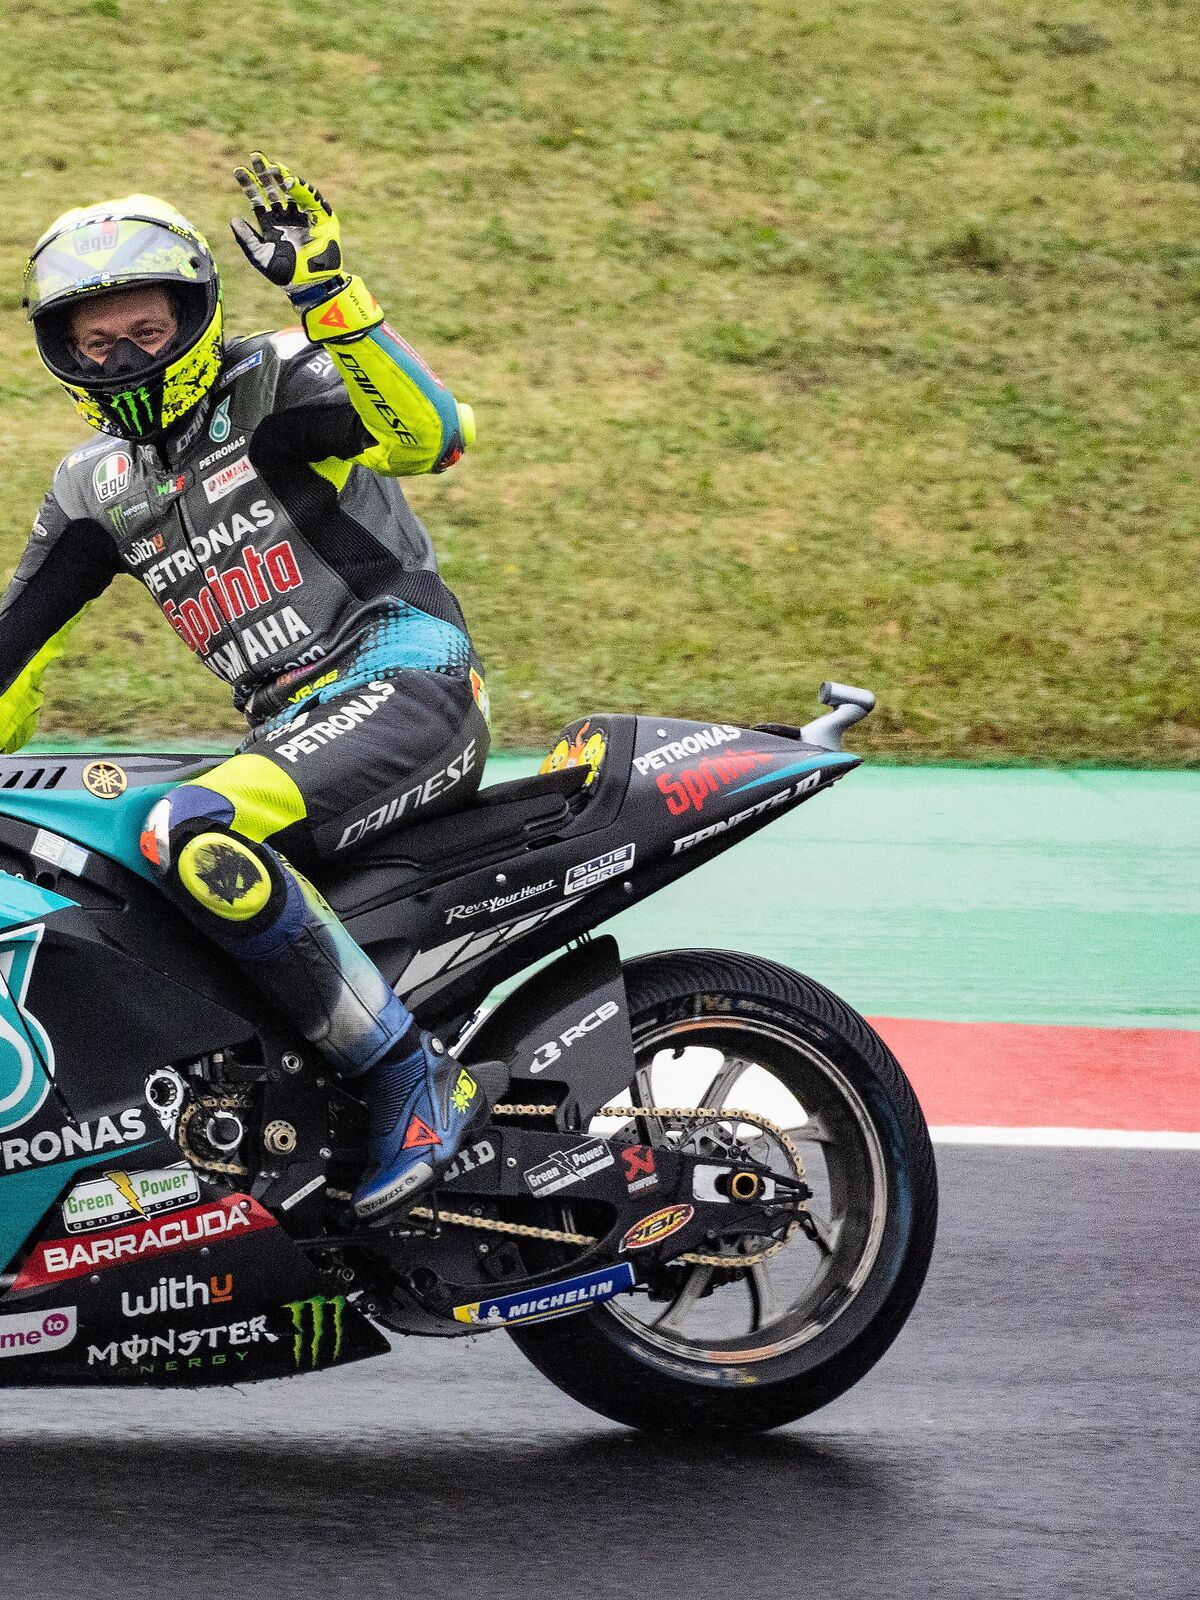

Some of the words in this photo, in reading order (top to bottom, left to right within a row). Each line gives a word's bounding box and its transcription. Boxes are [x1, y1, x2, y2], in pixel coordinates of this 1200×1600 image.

[80, 235, 113, 252] agv
[337, 352, 418, 446] DAINESE
[199, 436, 246, 470] PETRONAS
[216, 460, 250, 487] YAMAHA
[101, 474, 126, 496] agv
[143, 500, 275, 596] PETRONAS
[163, 540, 302, 656] Sprinta
[205, 606, 312, 684] YAMAHA
[274, 680, 396, 763] PETRONAS
[633, 724, 742, 776] PETRONAS
[335, 739, 477, 852] DAINESE
[572, 862, 625, 890] CORE
[573, 849, 628, 879] BLUE
[560, 1001, 620, 1047] RCB
[528, 1165, 561, 1188] Green
[571, 1144, 605, 1167] Power
[67, 1193, 115, 1214] Green
[140, 1173, 189, 1198] Power
[43, 1203, 250, 1273] BARRACUDA
[508, 1280, 614, 1319] MICHELIN
[87, 1314, 279, 1367] MONSTER
[118, 1351, 248, 1375] NERGY
